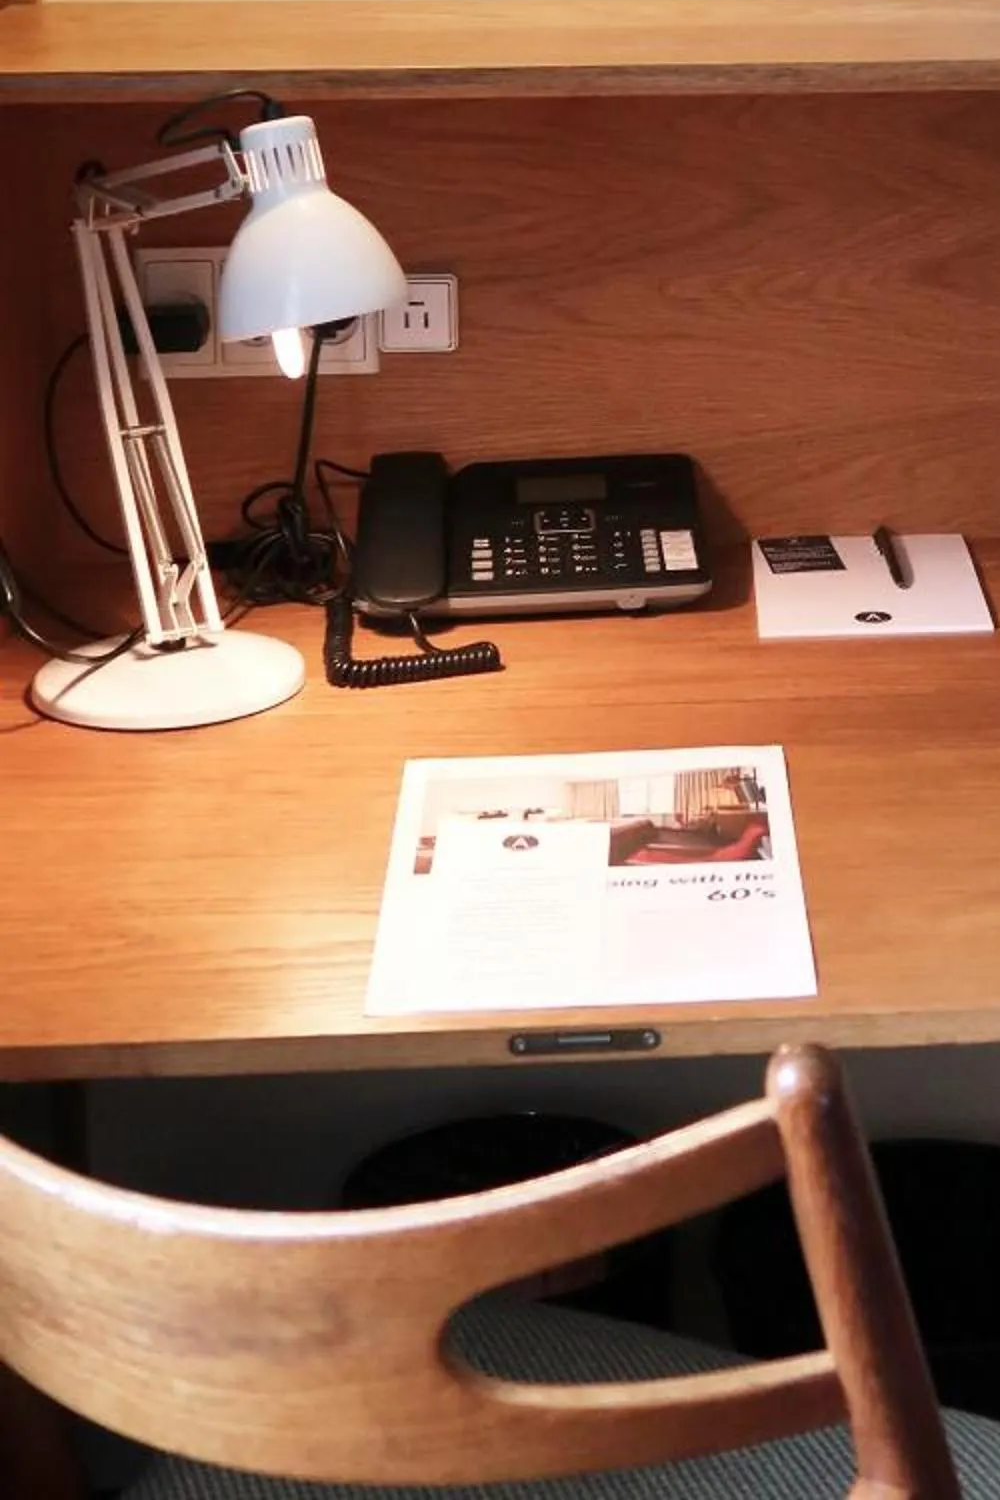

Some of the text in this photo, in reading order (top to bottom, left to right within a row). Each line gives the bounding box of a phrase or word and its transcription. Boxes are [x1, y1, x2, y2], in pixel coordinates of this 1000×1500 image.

[668, 873, 725, 885] with
[734, 871, 775, 884] the
[706, 886, 777, 902] 60's
